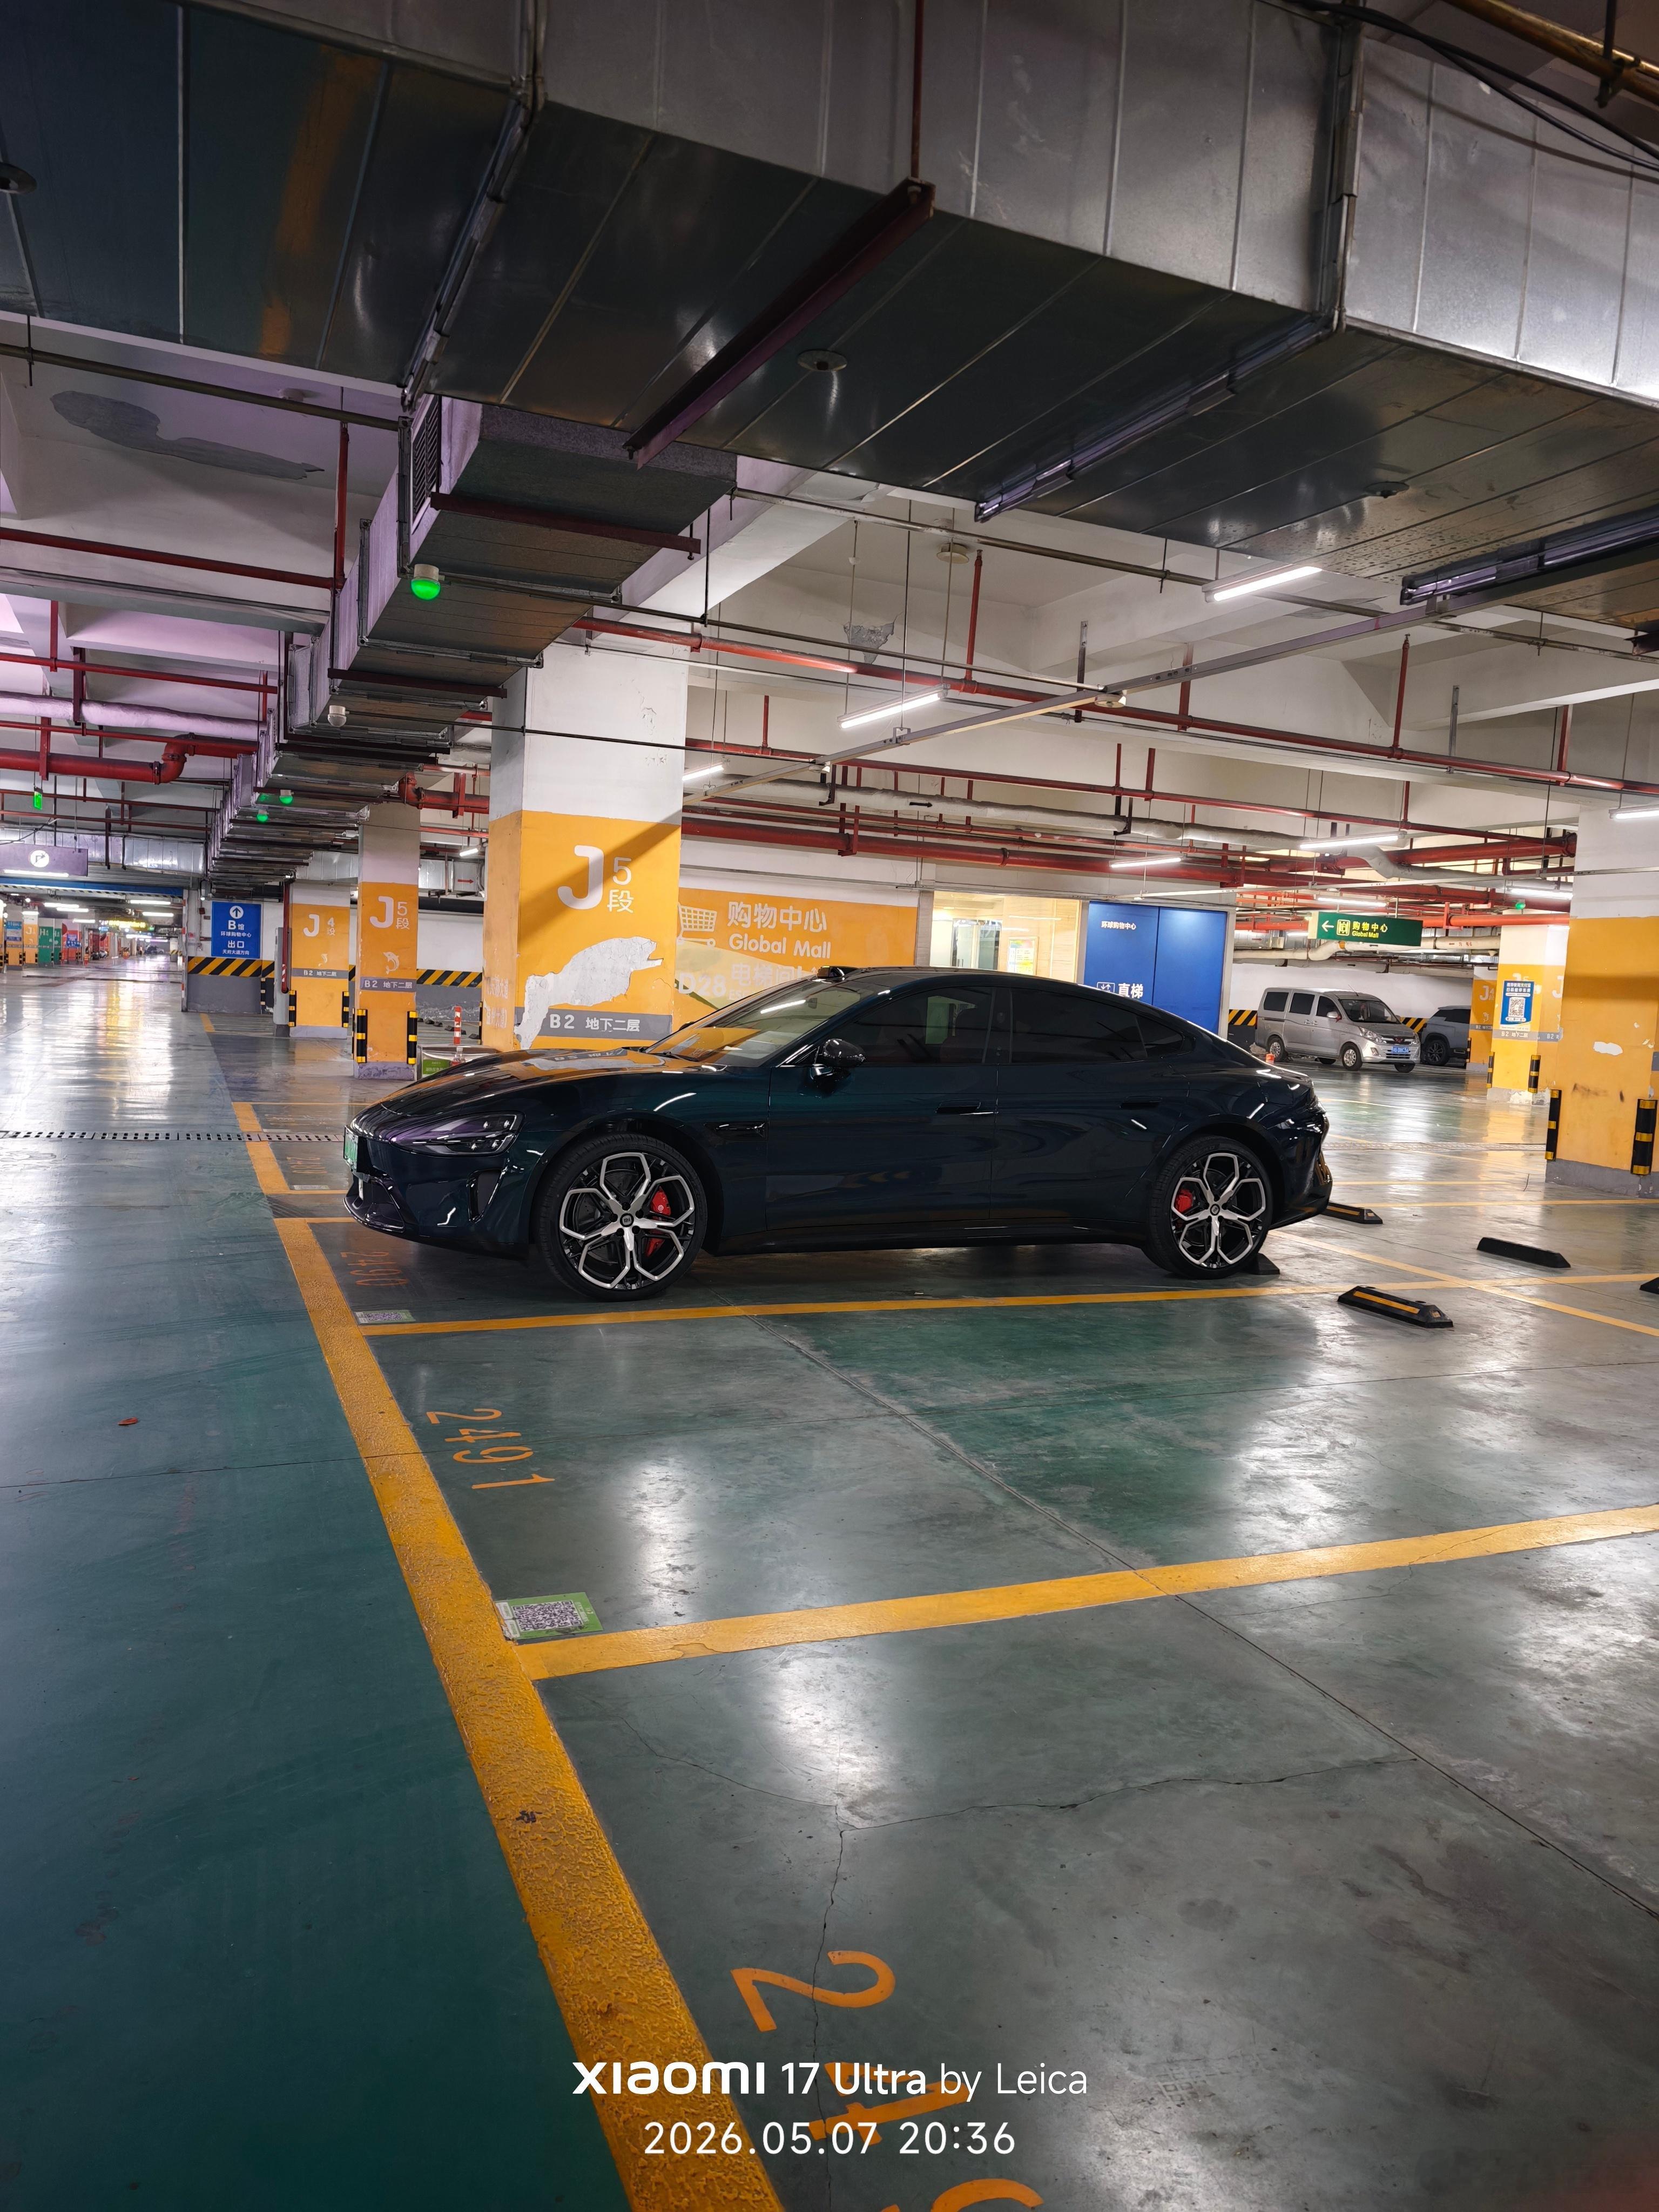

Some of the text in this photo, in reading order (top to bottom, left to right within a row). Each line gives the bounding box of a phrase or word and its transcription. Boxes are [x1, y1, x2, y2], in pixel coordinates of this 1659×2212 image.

[558, 845, 631, 909] J 5
[370, 896, 407, 928] J 5
[607, 889, 633, 913] 段
[228, 920, 237, 930] B
[304, 914, 334, 936] J 4
[396, 918, 410, 929] 段
[727, 901, 827, 933] 购物中心
[1101, 921, 1136, 930] 环球购物中心
[1352, 921, 1388, 933] 购物中心
[227, 940, 245, 948] 出口
[729, 933, 832, 959] Global Mall
[364, 980, 413, 989] B2 地下二层
[678, 972, 726, 997] D28
[1118, 983, 1144, 999] 直梯
[550, 1014, 640, 1033] B2 地下二层
[340, 1251, 410, 1286] 2490
[427, 1408, 555, 1489] 2491
